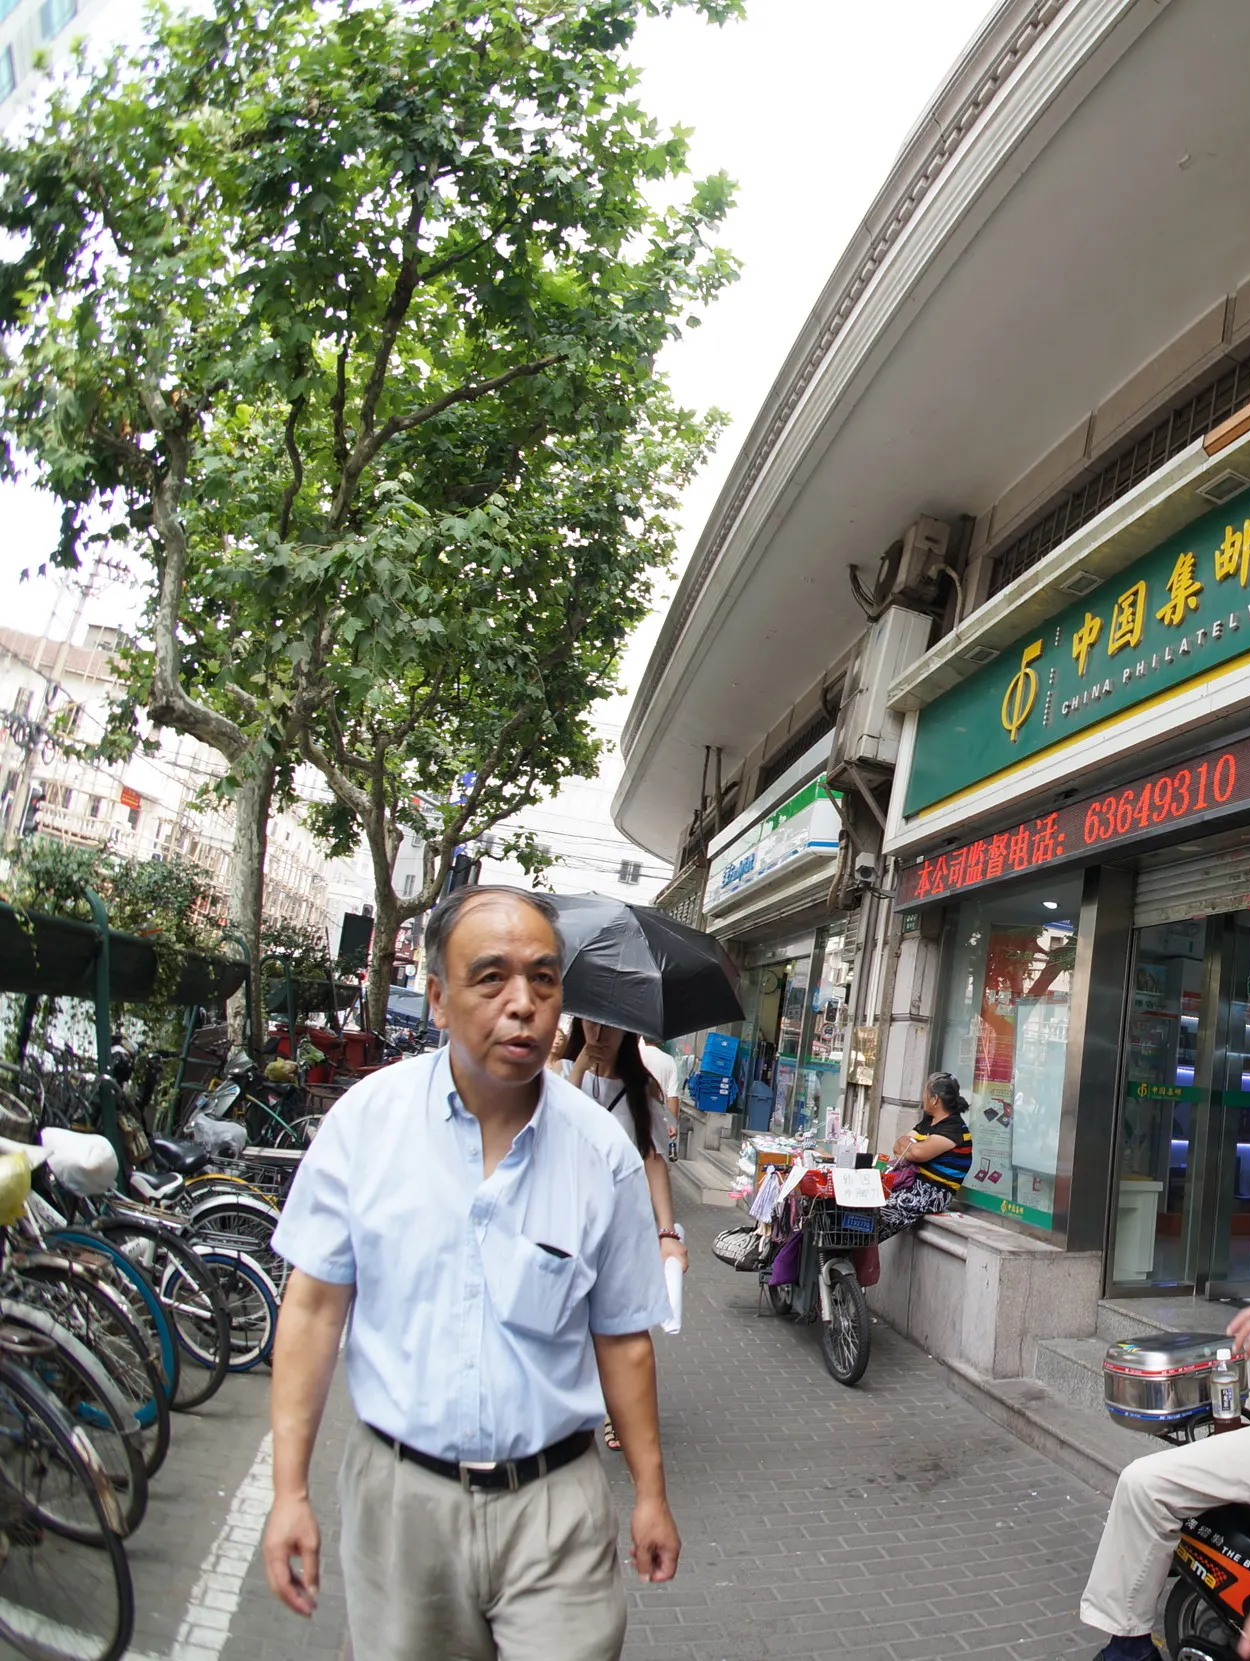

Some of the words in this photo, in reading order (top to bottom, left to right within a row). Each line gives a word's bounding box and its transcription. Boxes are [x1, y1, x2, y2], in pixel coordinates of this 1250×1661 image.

[1061, 679, 1113, 715] CHINA
[1083, 753, 1237, 845] 63649310
[1221, 1546, 1242, 1562] THE
